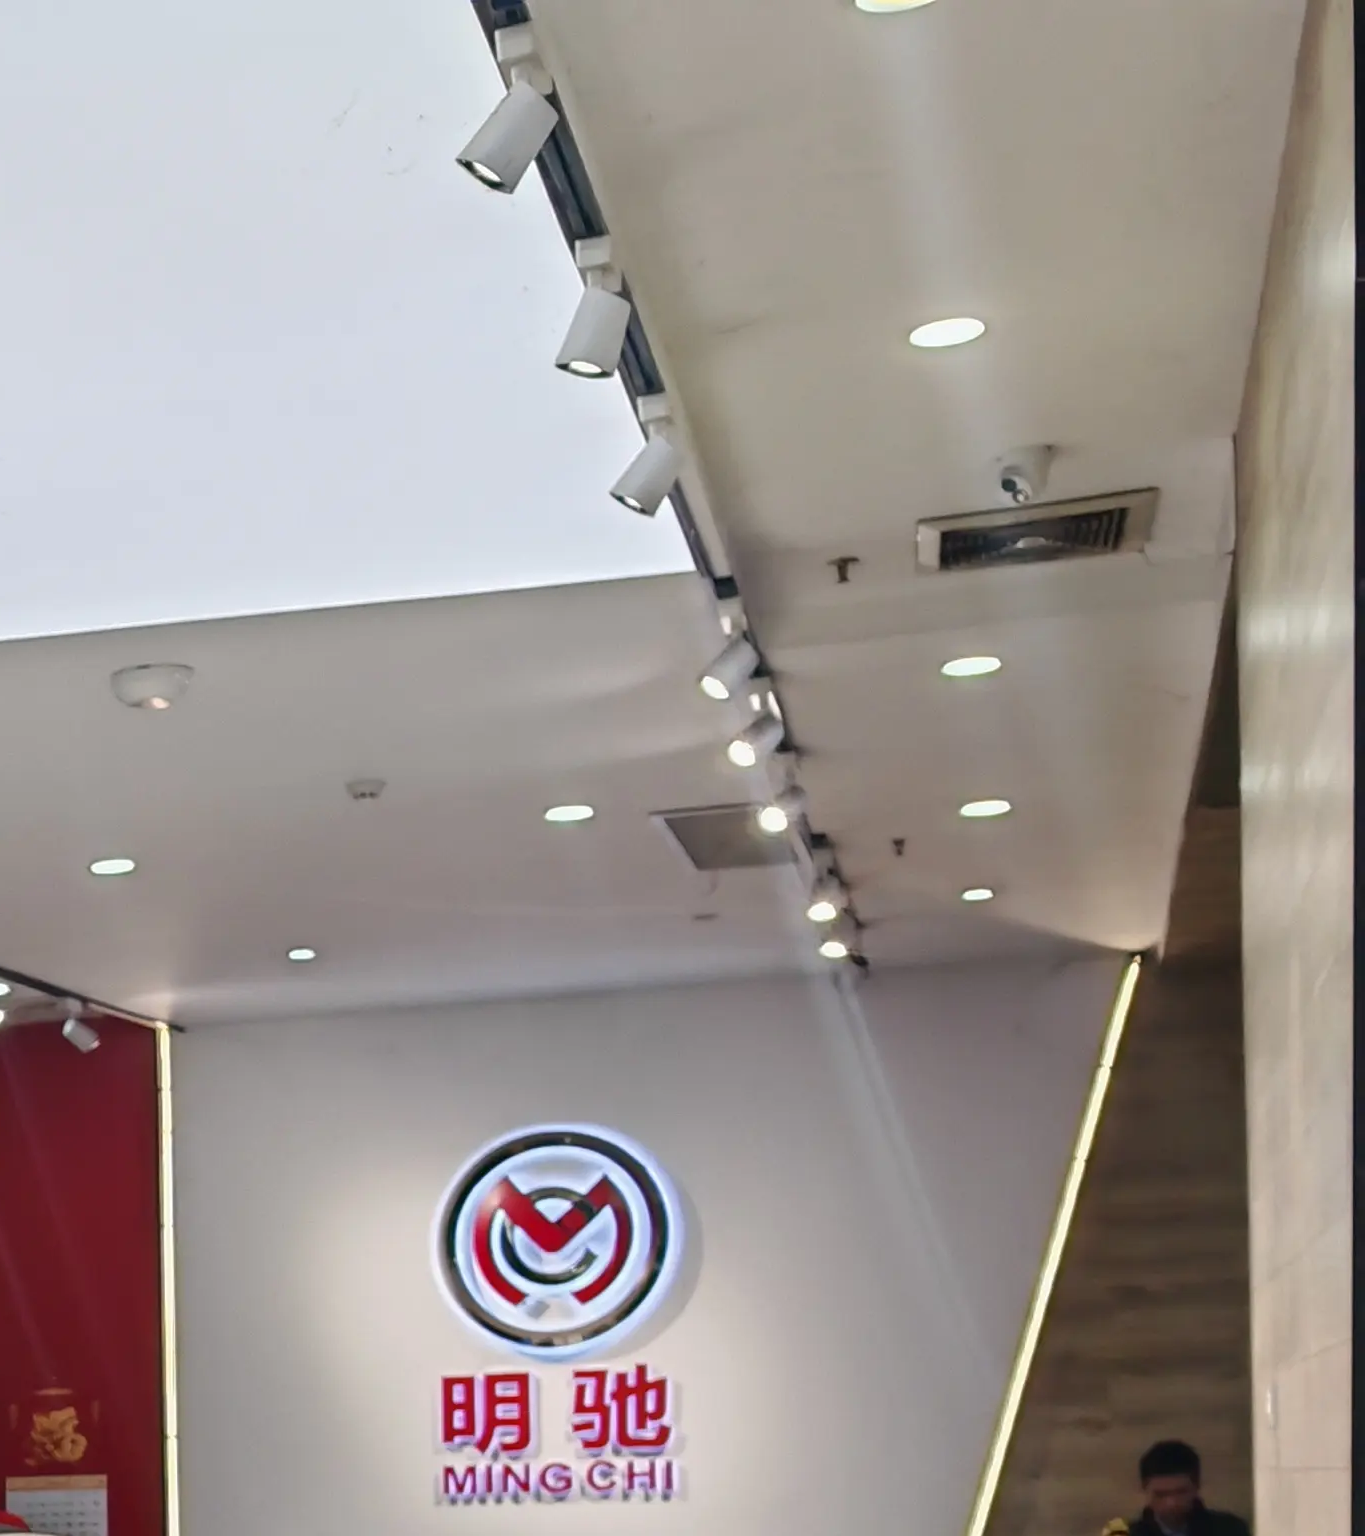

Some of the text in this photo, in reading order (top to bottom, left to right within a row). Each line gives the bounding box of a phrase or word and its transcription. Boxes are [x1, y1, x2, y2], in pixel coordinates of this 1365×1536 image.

[441, 1364, 671, 1453] 明驰
[442, 1459, 675, 1495] MING CHI
